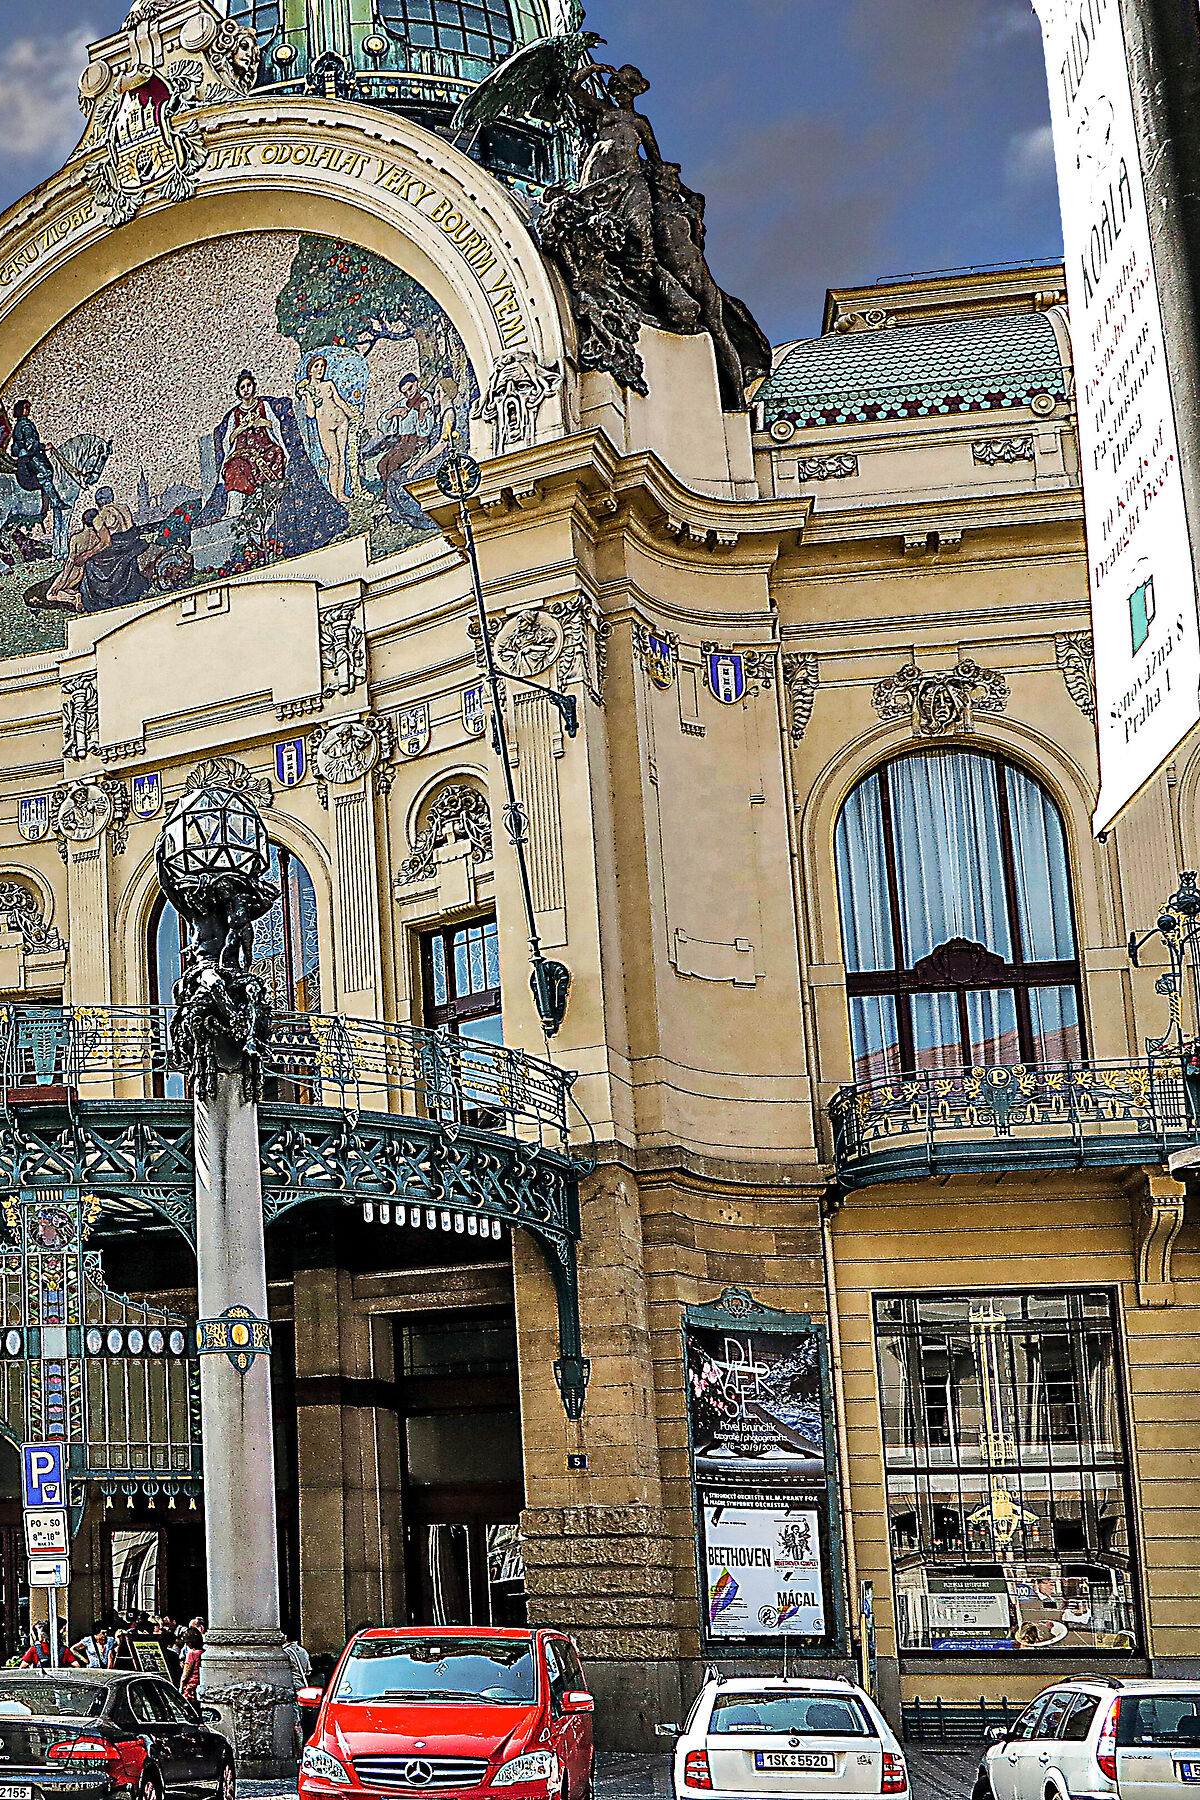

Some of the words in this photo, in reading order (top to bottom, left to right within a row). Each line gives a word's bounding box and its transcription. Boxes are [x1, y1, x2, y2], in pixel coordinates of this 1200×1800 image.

[207, 145, 255, 171] JAK
[259, 144, 371, 179] ODOLALAS
[1081, 157, 1132, 309] KOALA
[1125, 687, 1161, 744] Praha
[1165, 668, 1171, 692] 1
[30, 1451, 55, 1489] P
[573, 1457, 581, 1467] 5
[30, 1519, 41, 1528] PO
[49, 1518, 61, 1527] SO
[708, 1546, 771, 1567] BEETHOVEN
[777, 1589, 819, 1607] MÁCAL
[766, 1754, 790, 1765] 1SK
[797, 1755, 828, 1766] 5520
